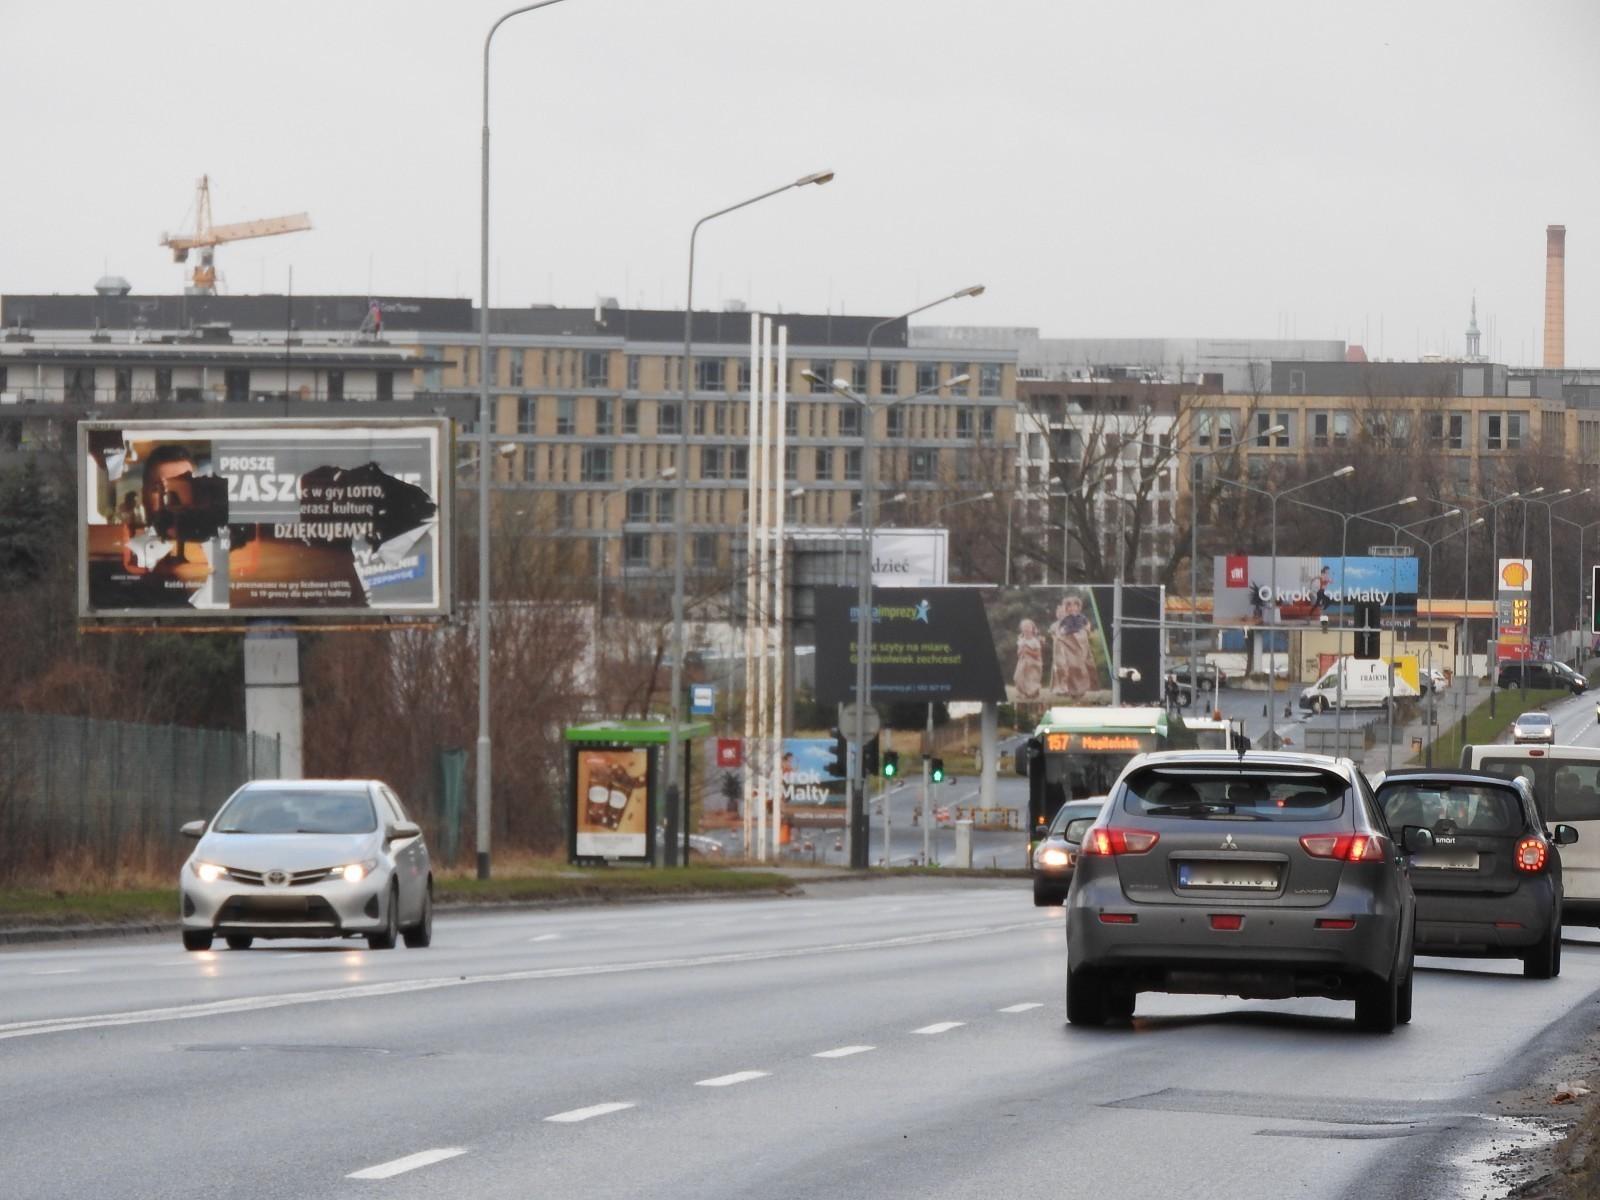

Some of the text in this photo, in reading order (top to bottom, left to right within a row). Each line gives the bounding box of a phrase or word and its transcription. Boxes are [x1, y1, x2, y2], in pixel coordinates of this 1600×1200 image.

[220, 456, 275, 473] PROSZĘ
[227, 473, 302, 502] ZASZ
[311, 489, 322, 498] w
[325, 488, 344, 500] gry
[347, 485, 385, 498] LOTTO,
[333, 501, 374, 516] kulturę
[274, 522, 374, 546] DZIĘKUJEMY!
[1258, 585, 1273, 602] O
[1276, 586, 1311, 602] krok
[1347, 587, 1389, 607] Malty
[1047, 734, 1070, 751] 157
[781, 784, 830, 805] Malty
